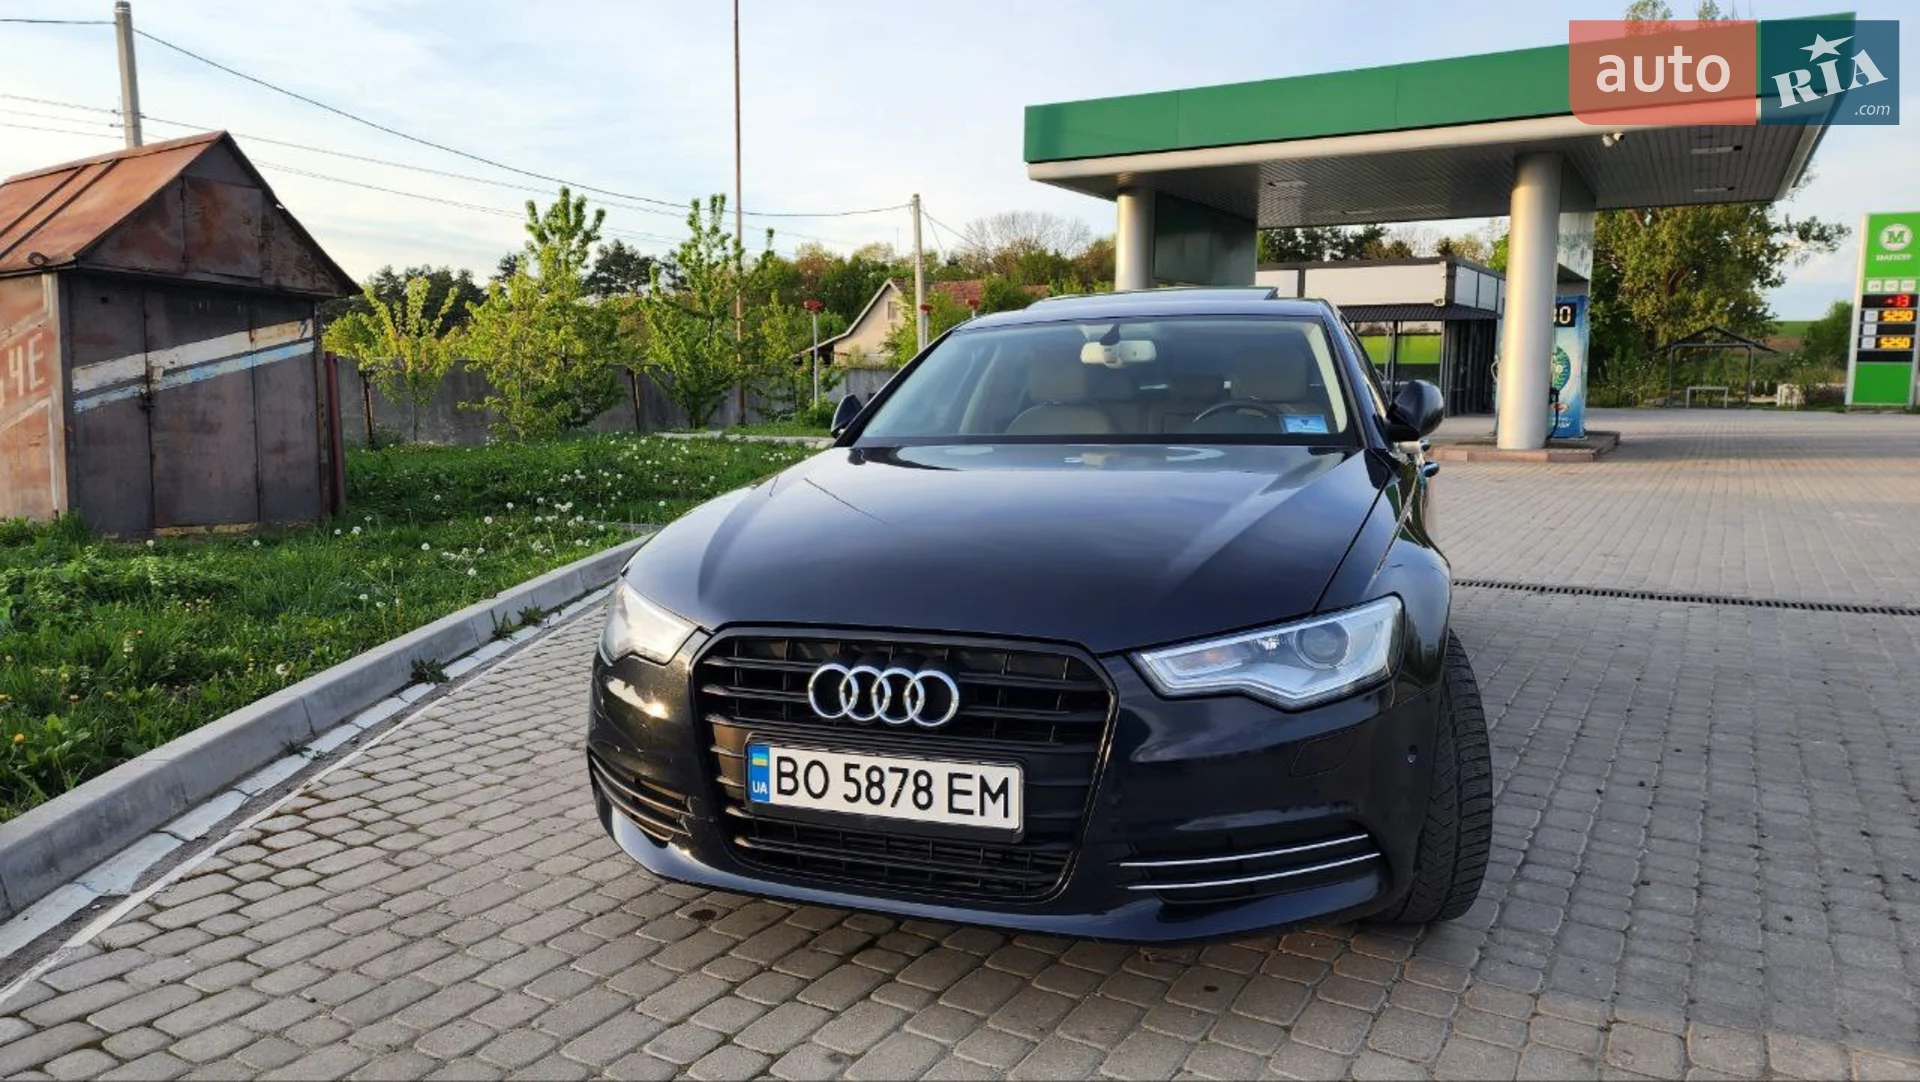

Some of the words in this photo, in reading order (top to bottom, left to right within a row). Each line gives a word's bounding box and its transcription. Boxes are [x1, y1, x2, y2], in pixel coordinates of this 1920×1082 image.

[752, 780, 768, 795] UA
[776, 756, 830, 799] BO
[843, 763, 934, 811] 5878
[947, 772, 1009, 818] EM
